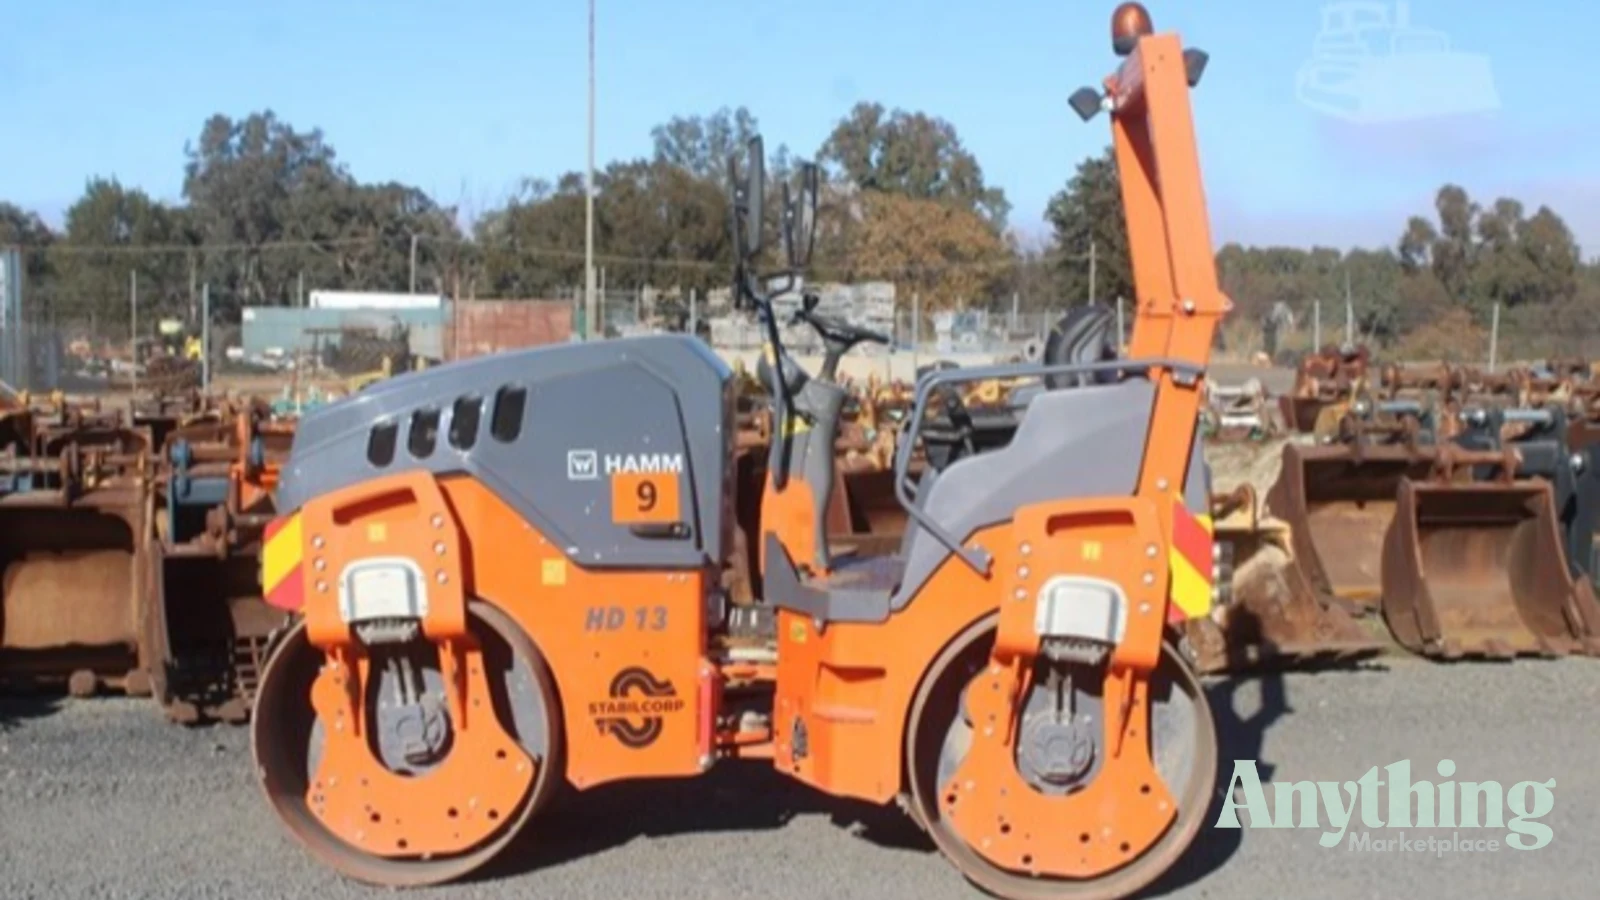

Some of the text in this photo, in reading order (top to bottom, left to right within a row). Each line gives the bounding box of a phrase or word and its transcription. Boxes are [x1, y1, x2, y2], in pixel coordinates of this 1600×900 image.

[604, 453, 683, 474] HAMM
[636, 480, 657, 512] 9
[585, 606, 668, 631] HD 13
[588, 699, 685, 715] STABILCORP
